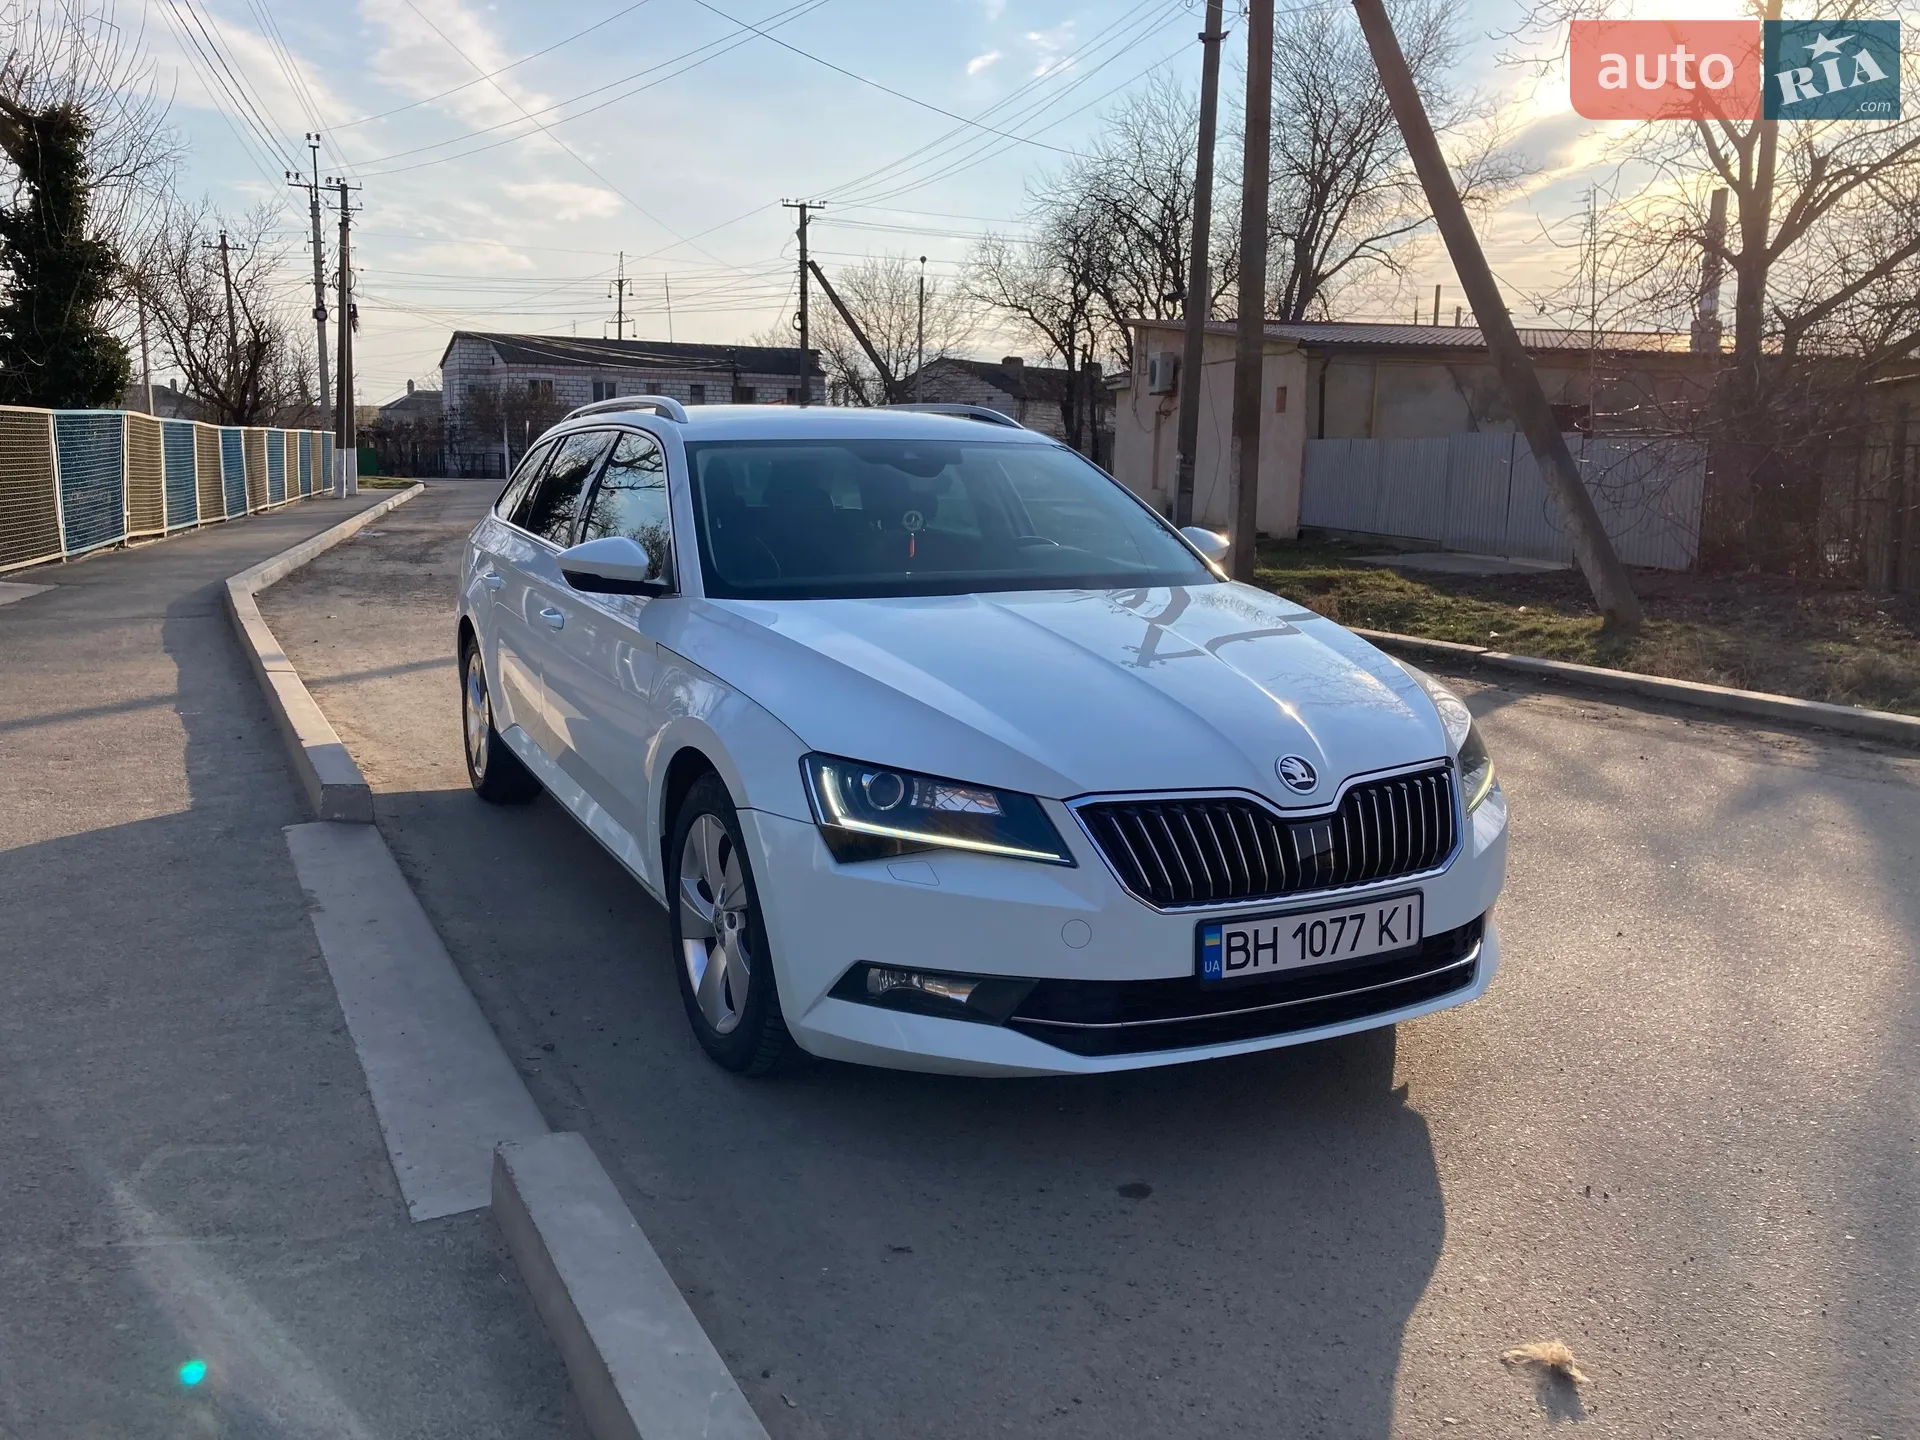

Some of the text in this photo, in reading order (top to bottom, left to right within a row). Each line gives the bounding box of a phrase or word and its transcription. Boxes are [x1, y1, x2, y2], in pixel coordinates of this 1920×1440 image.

[1225, 904, 1412, 971] BH 1077 KI
[1204, 960, 1220, 973] UA
